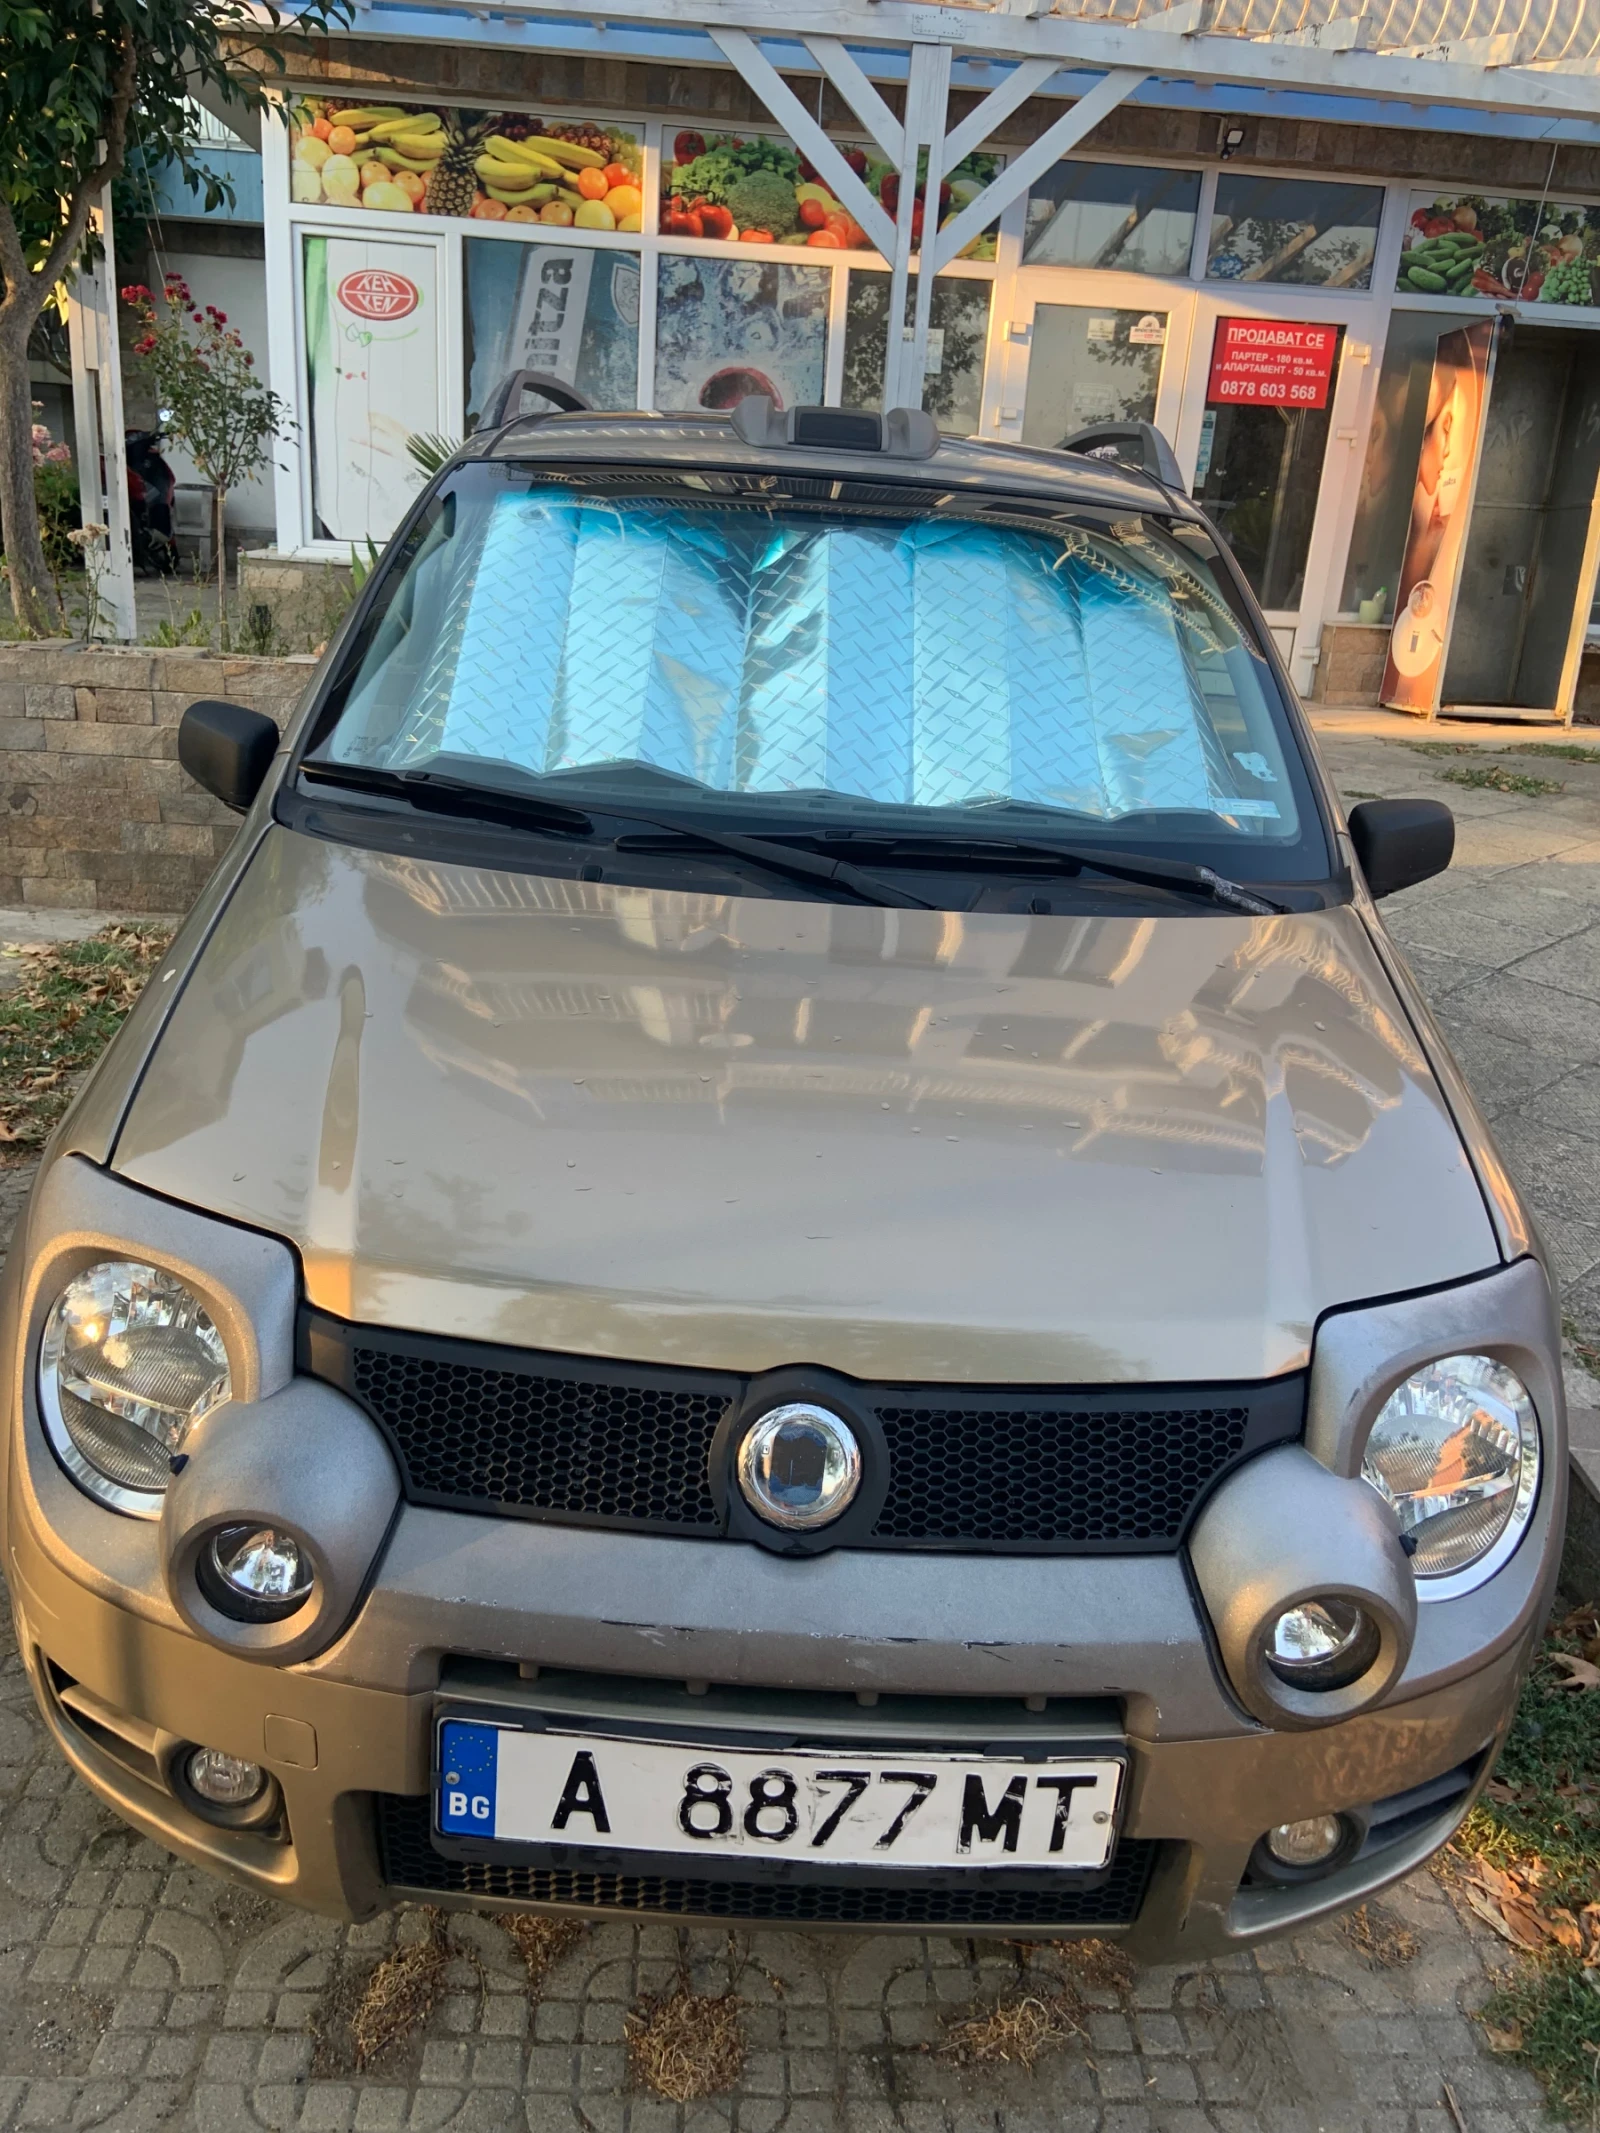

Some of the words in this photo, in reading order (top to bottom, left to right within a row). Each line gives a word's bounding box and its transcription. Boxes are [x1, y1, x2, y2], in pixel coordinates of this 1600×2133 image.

[356, 294, 399, 313] KEN
[1227, 328, 1303, 346] ПРОДАВАТ
[1305, 333, 1325, 347] СЕ
[1231, 351, 1268, 362] ПАРТЕР
[1276, 355, 1291, 364] 180
[1223, 362, 1286, 374] АПАРТАМЕНТ
[1293, 367, 1303, 376] 50
[1220, 380, 1255, 396] 0878
[1259, 383, 1285, 398] 603
[1290, 385, 1316, 400] 568
[449, 1792, 490, 1820] BG
[550, 1751, 611, 1833] A
[677, 1762, 938, 1851] 8877
[956, 1773, 1098, 1854] MT
